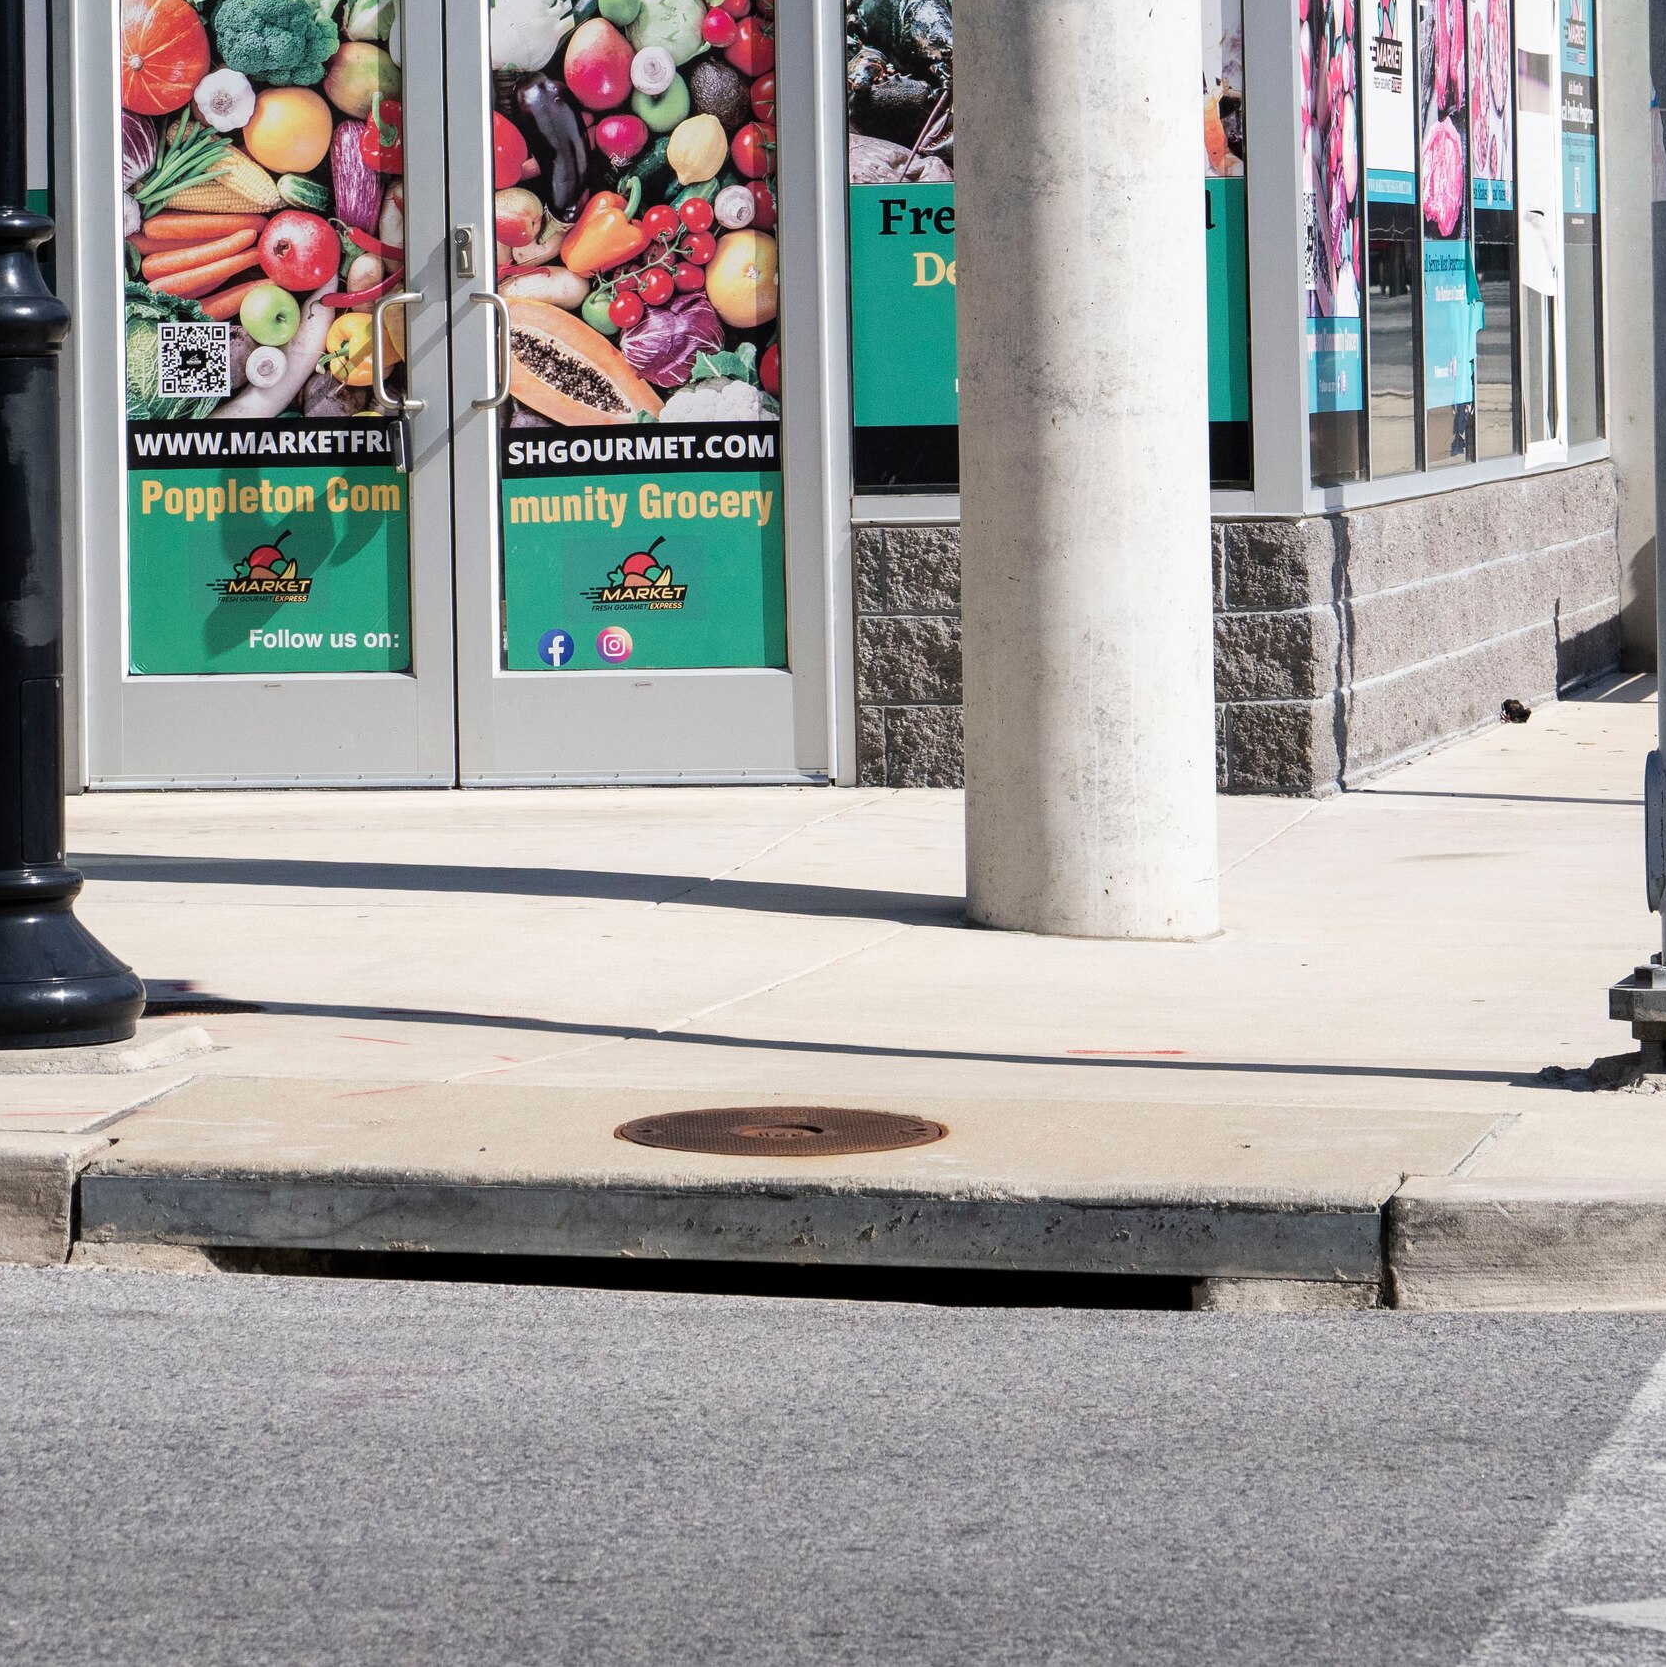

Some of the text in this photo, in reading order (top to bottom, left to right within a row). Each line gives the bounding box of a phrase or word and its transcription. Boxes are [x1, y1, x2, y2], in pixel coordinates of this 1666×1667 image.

[1377, 40, 1402, 71] MARKET
[508, 434, 775, 465] SHGOURMET.COM
[141, 476, 401, 521] Poppleton Com
[510, 483, 773, 528] munity Grocery
[228, 580, 311, 593] MARKET
[602, 586, 686, 601] MARKET
[239, 595, 273, 603] GOURMET
[274, 594, 308, 603] EXPRESS
[591, 602, 683, 612] FRESH GOURMET EXPRESS
[249, 629, 399, 648] Follow us on:
